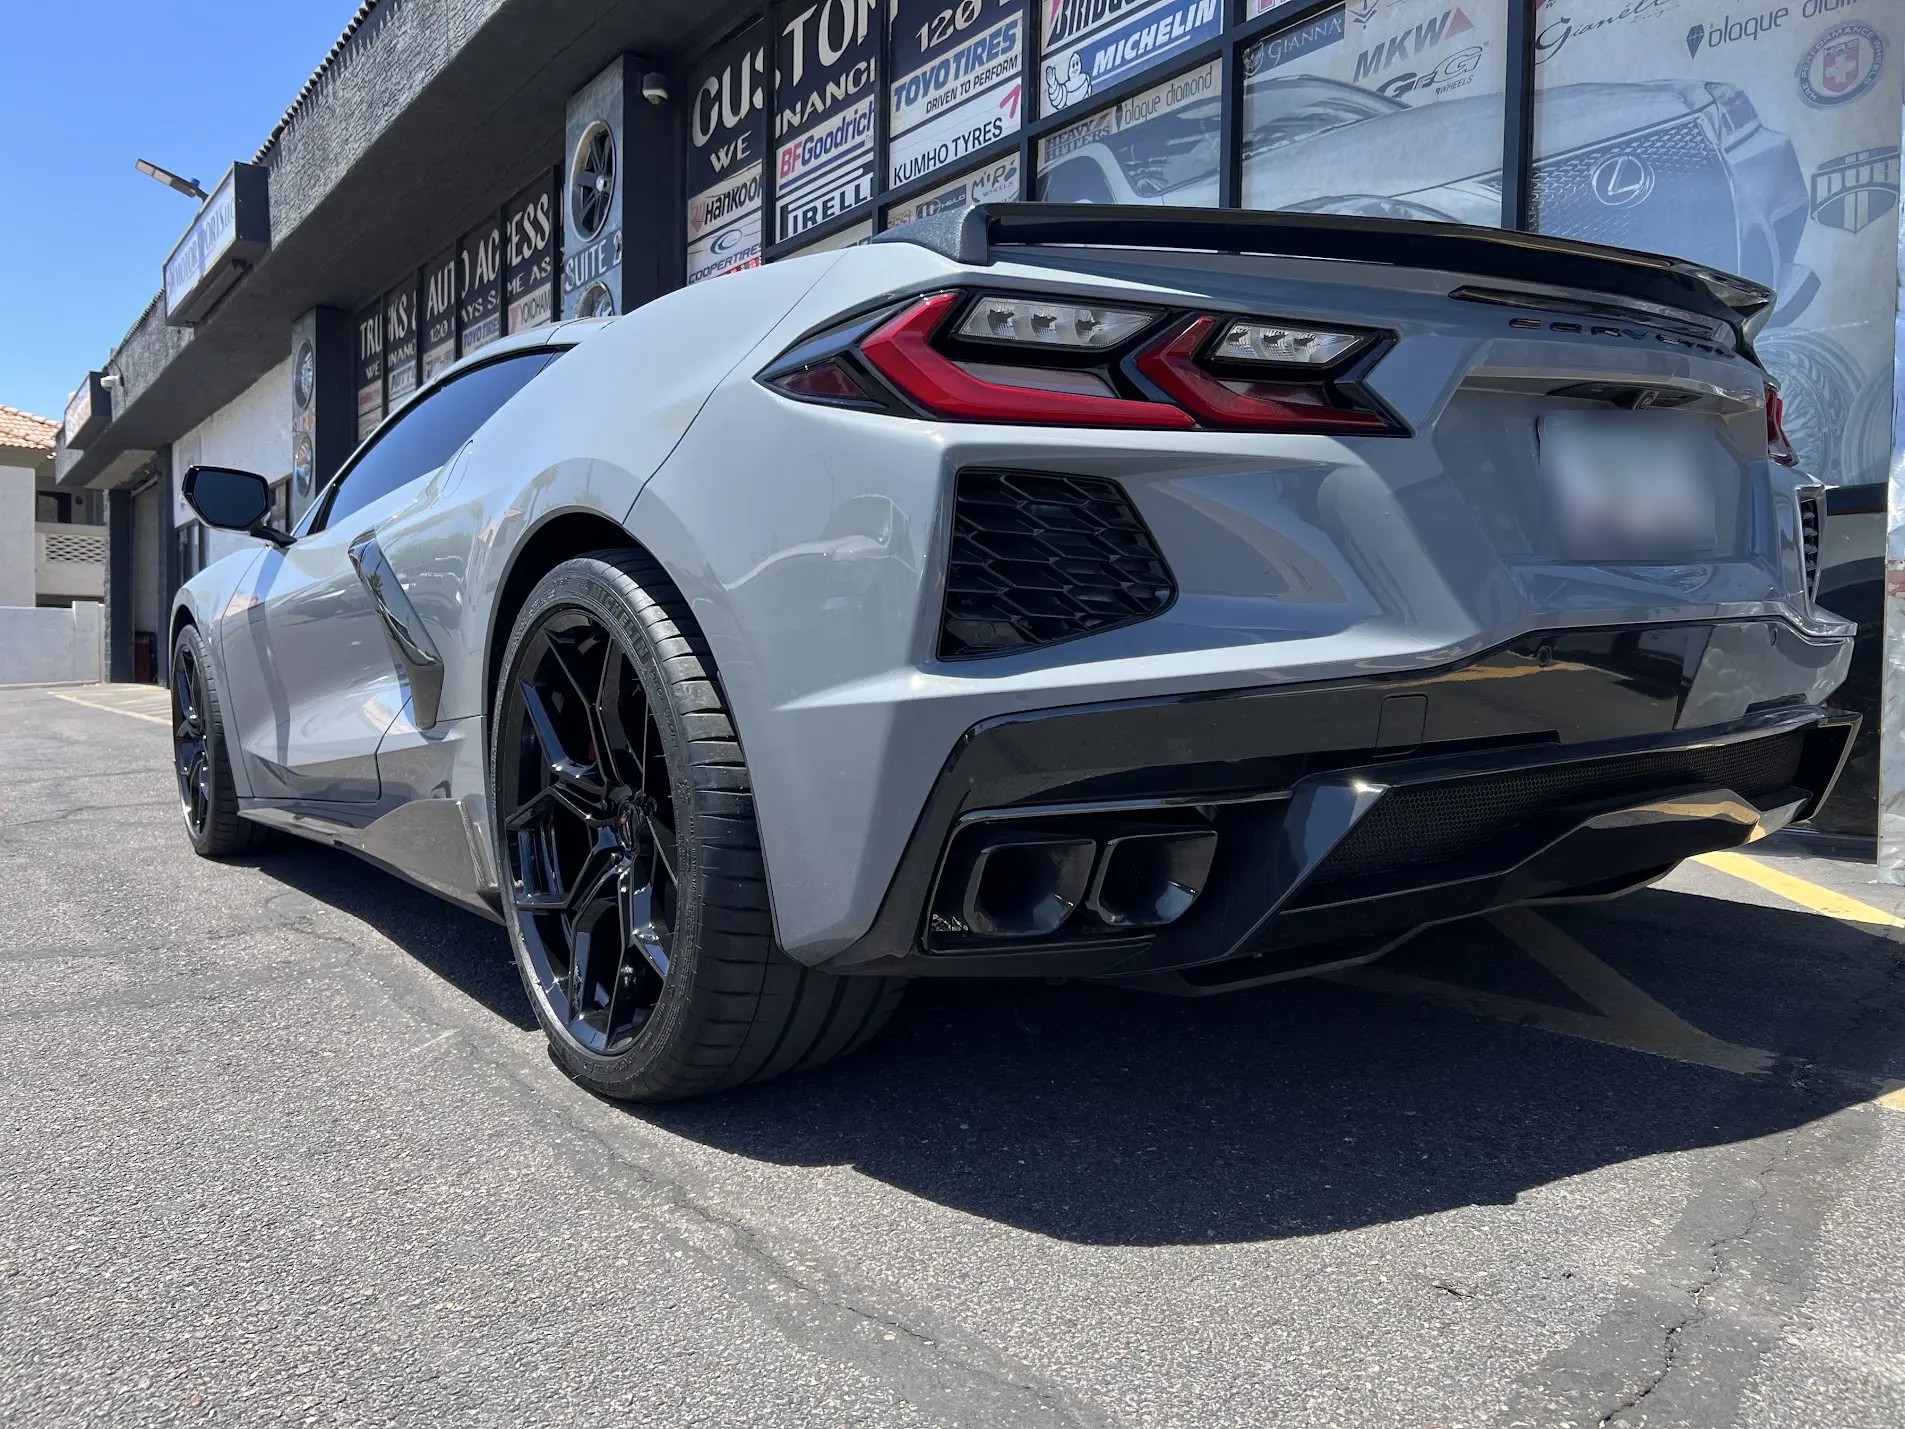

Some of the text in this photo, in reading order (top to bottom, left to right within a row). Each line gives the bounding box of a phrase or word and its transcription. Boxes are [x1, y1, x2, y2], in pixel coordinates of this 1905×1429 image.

[1092, 0, 1217, 77] MICHELIN
[1268, 17, 1342, 67] GIANNA
[1353, 9, 1452, 83] MKW
[710, 131, 752, 174] WE
[915, 0, 982, 53] 120
[926, 54, 1019, 115] DRIVEN TO PERFORM
[893, 117, 1003, 186] KUMHO TYRES
[1046, 119, 1095, 147] HEAVY
[565, 238, 607, 292] SUITE
[366, 361, 380, 380] WE
[430, 320, 448, 343] 120
[585, 579, 652, 664] MICHELIN
